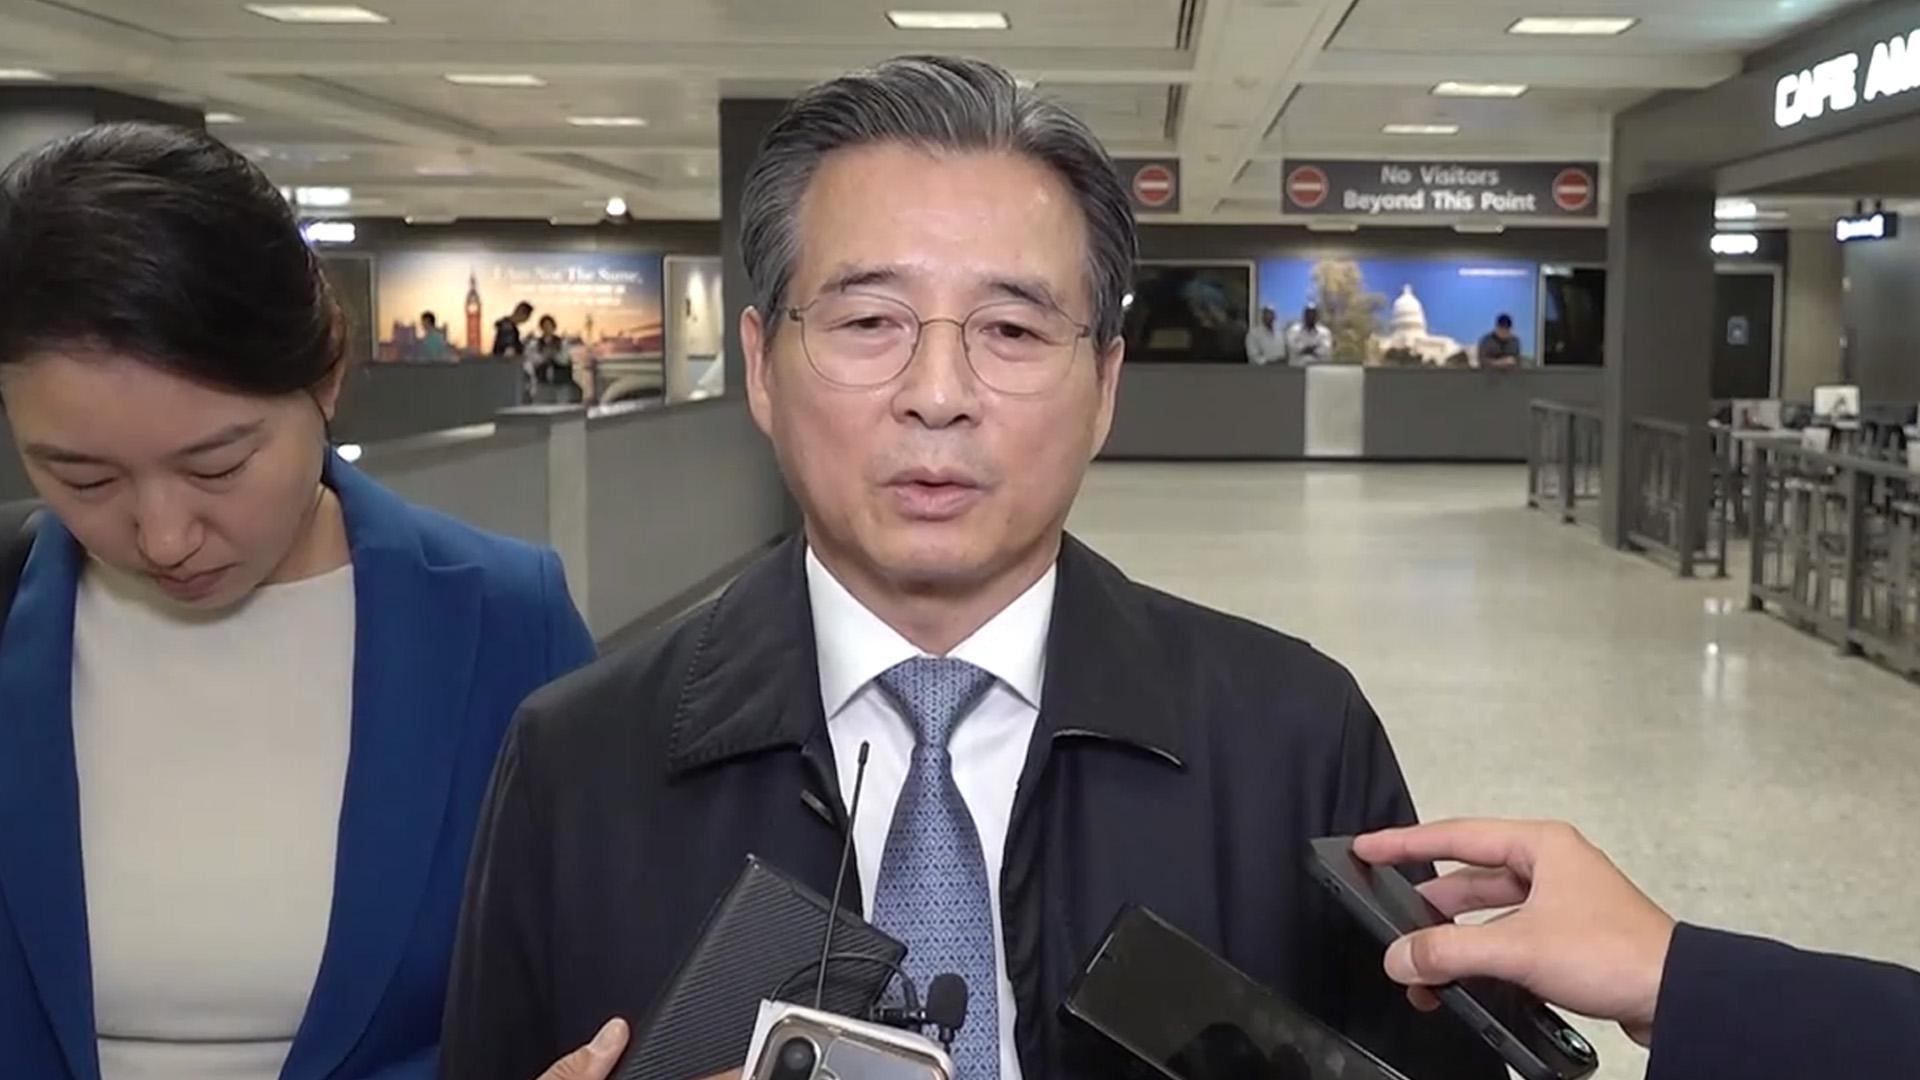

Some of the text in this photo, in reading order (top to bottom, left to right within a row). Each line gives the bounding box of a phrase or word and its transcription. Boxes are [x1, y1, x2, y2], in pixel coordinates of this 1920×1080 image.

[1774, 51, 1859, 128] CAFE
[1381, 165, 1500, 186] No Visitors
[1342, 189, 1537, 215] Beyond This Point
[567, 265, 596, 281] The
